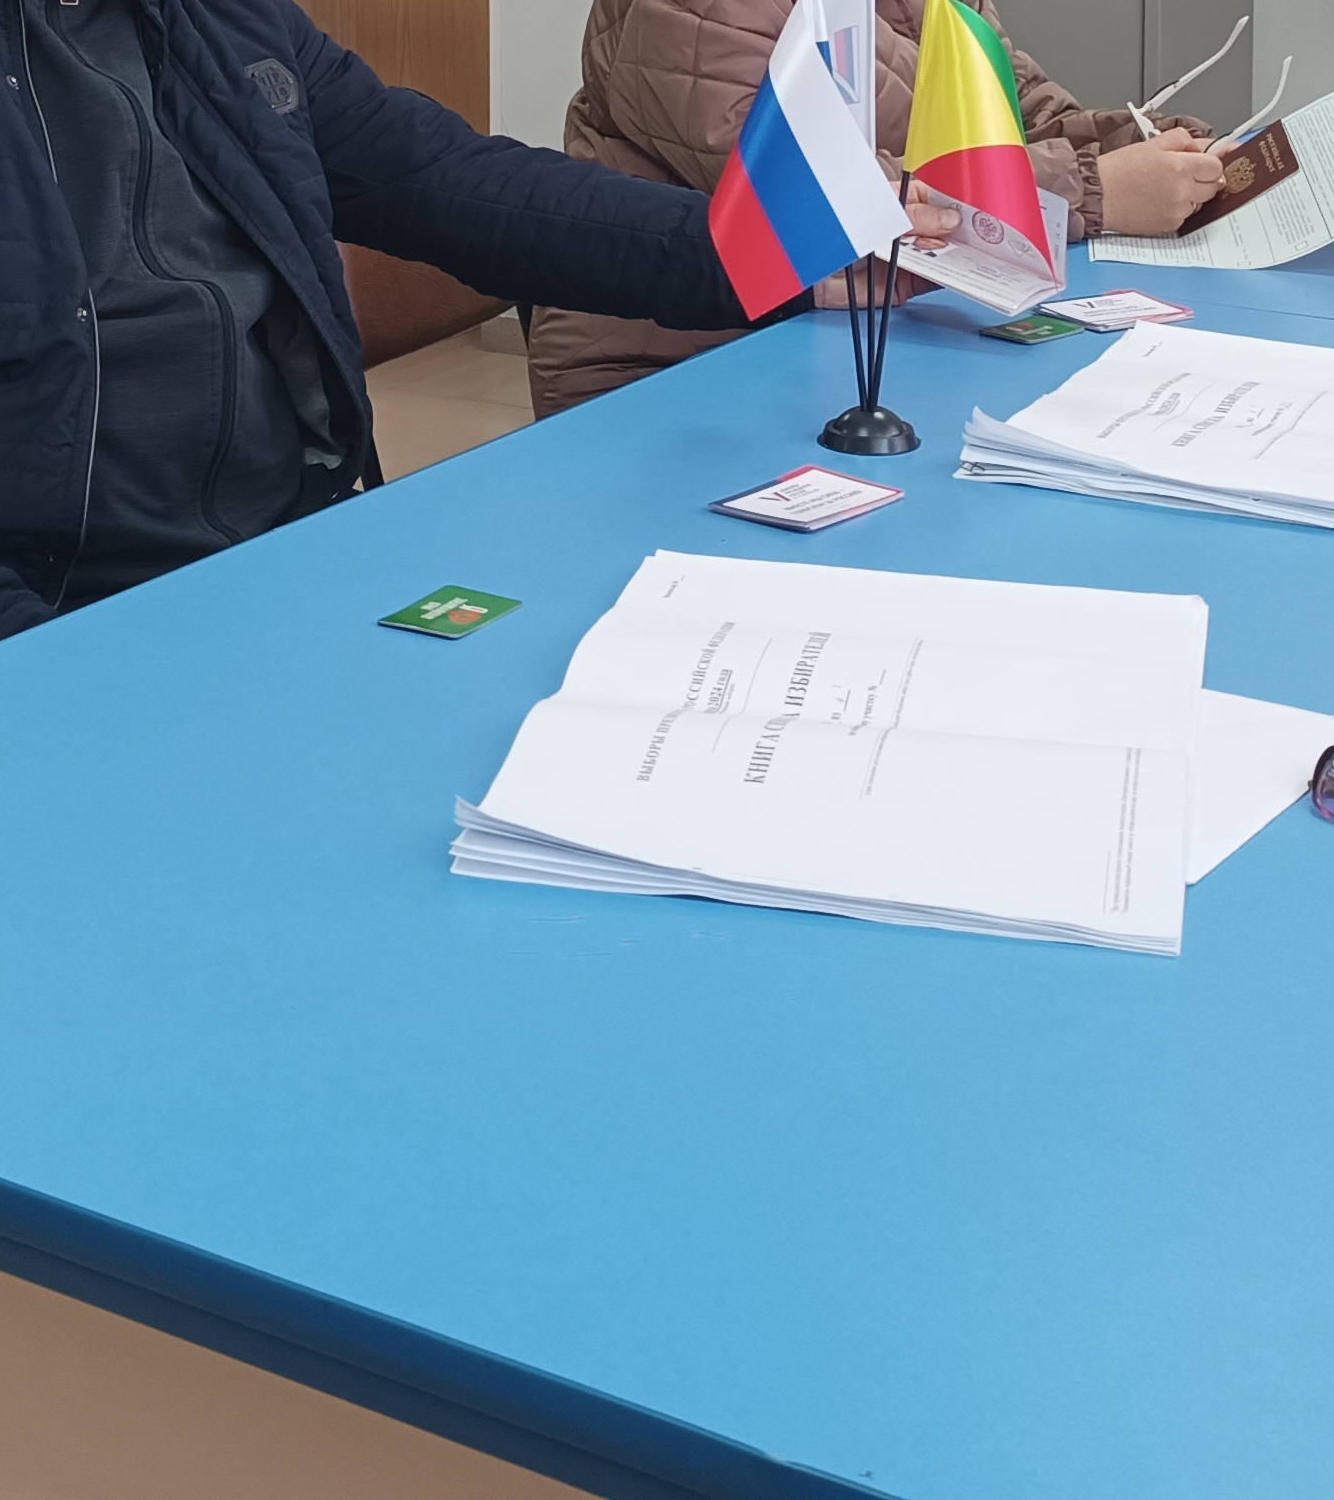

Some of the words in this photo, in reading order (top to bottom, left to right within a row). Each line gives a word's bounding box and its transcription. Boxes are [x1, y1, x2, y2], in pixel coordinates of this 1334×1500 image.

[708, 686, 723, 708] 2024
[717, 668, 731, 686] года
[744, 731, 780, 784] КНИГА
[784, 632, 832, 706] ИЗБИРАТЕЛЕЙ
[637, 736, 666, 782] ВЫБОРЫ
